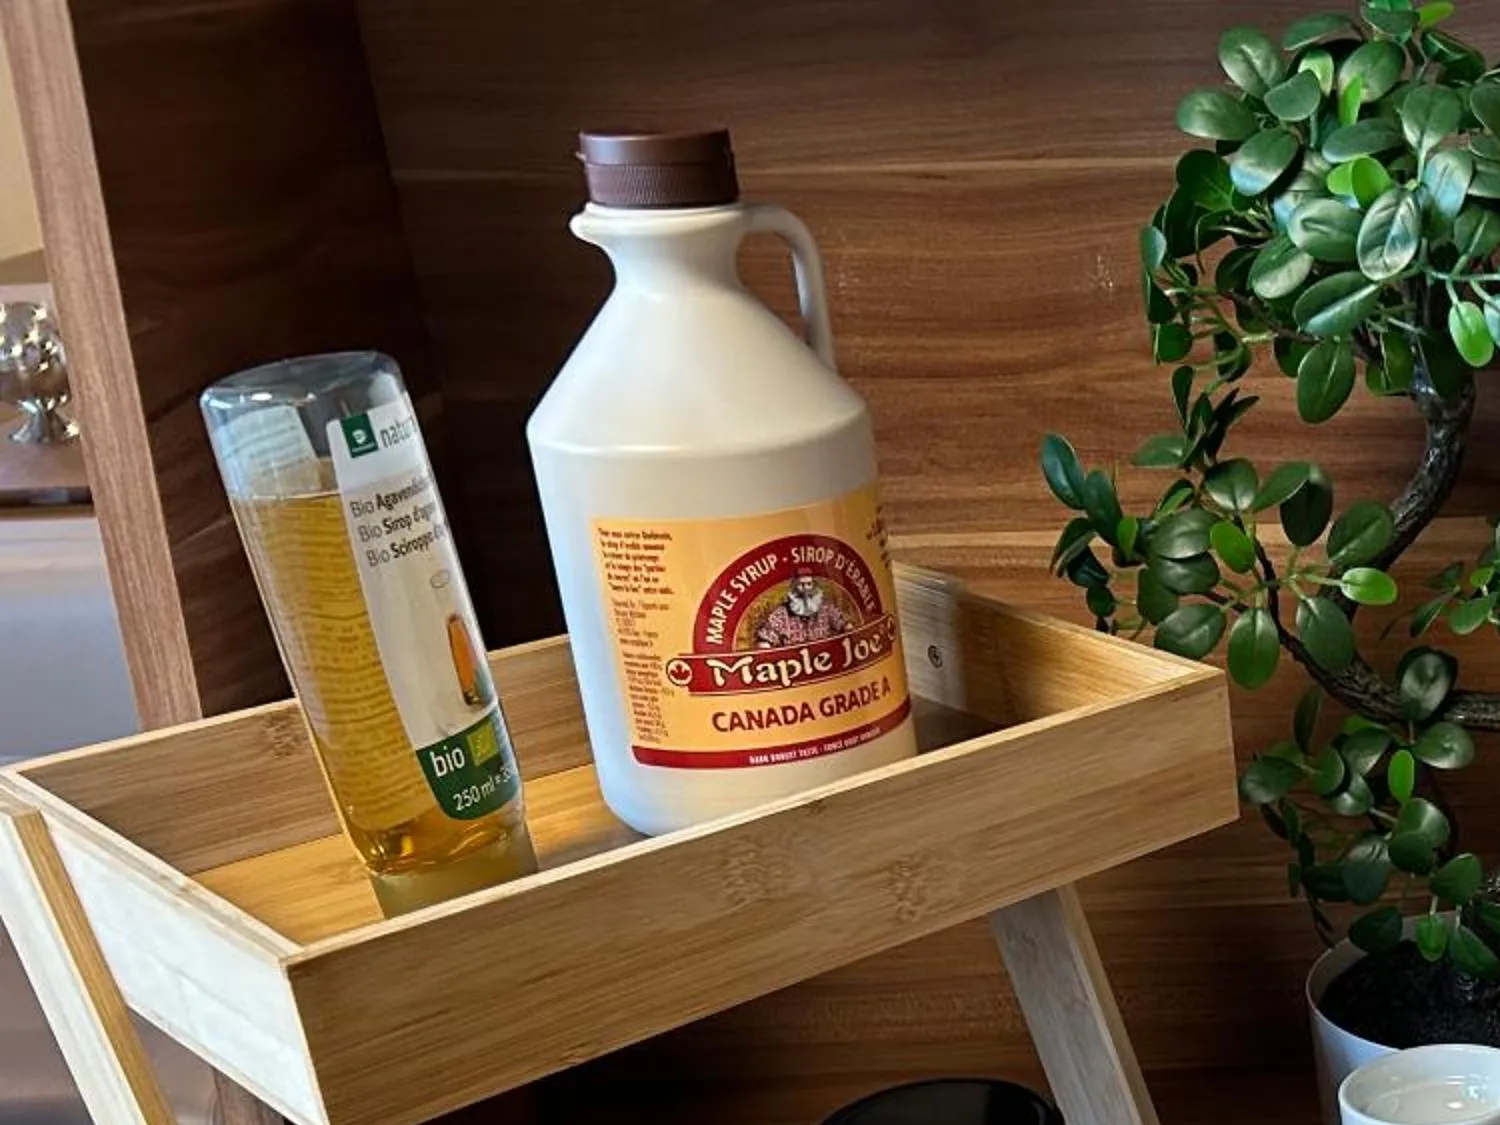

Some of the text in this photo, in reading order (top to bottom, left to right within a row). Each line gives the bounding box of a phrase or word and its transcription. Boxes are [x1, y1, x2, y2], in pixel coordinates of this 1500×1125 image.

[352, 499, 374, 517] Bio
[358, 525, 382, 542] Bio
[382, 514, 413, 535] Sirop
[366, 549, 390, 566] Bio
[706, 589, 738, 645] MAPLE
[730, 554, 778, 594] SYRUP
[791, 546, 834, 564] SIROP
[706, 648, 832, 687] Maple
[712, 675, 891, 733] CANADA GRADE A
[429, 745, 465, 778] bio
[452, 785, 481, 811] 250
[481, 775, 496, 799] ml
